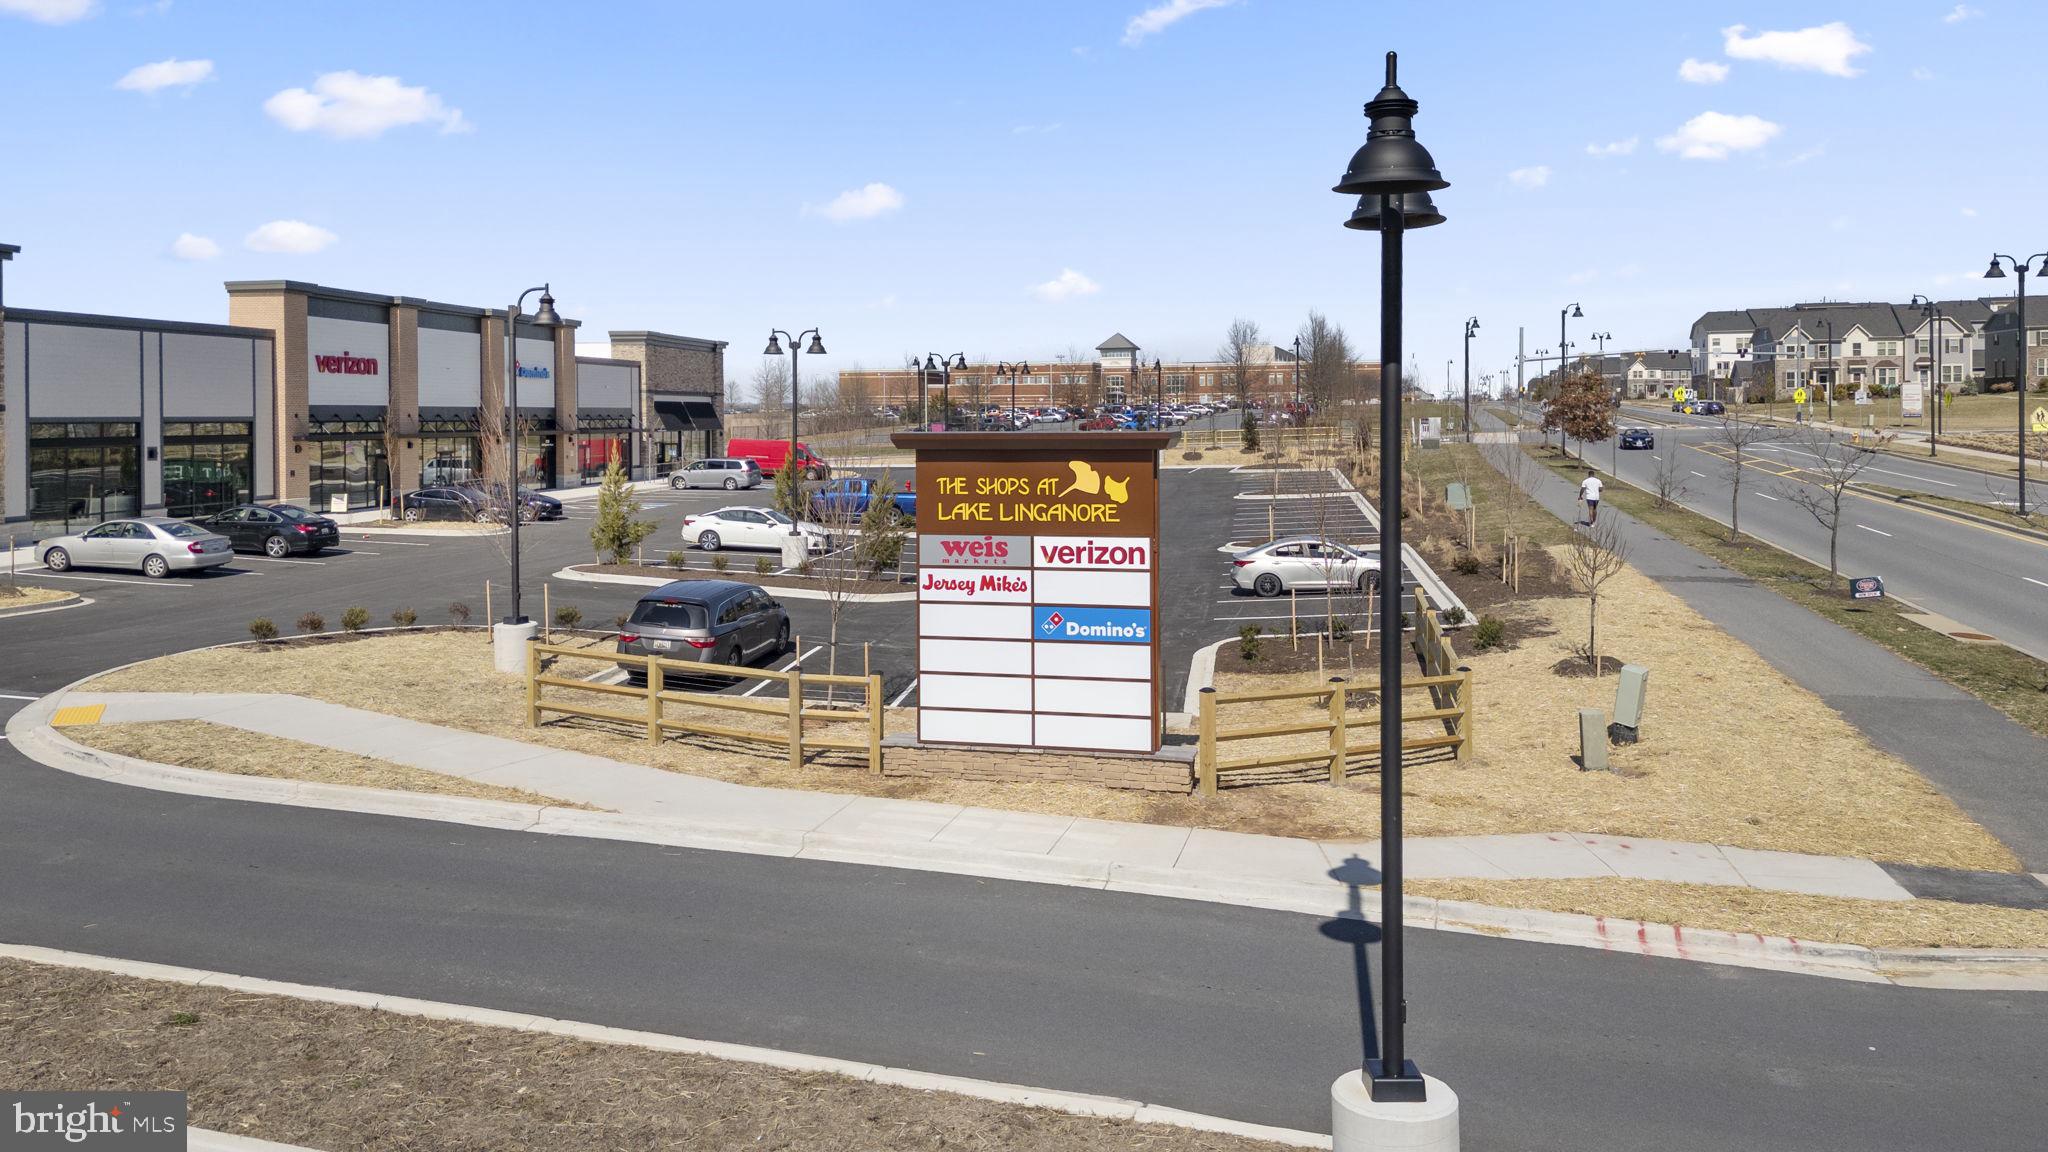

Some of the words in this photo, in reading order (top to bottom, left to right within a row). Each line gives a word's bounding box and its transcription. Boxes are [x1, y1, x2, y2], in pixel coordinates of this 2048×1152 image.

[315, 351, 379, 375] verizon
[936, 477, 969, 495] THE
[975, 477, 1029, 495] SHOPS
[1036, 477, 1059, 496] AT
[938, 502, 993, 521] LAKE
[999, 503, 1120, 523] LINGANORE
[940, 536, 1008, 557] weis
[1040, 540, 1145, 565] verizon
[922, 574, 975, 596] Jersey
[980, 575, 1028, 592] Mike's
[1066, 621, 1147, 638] Domino's
